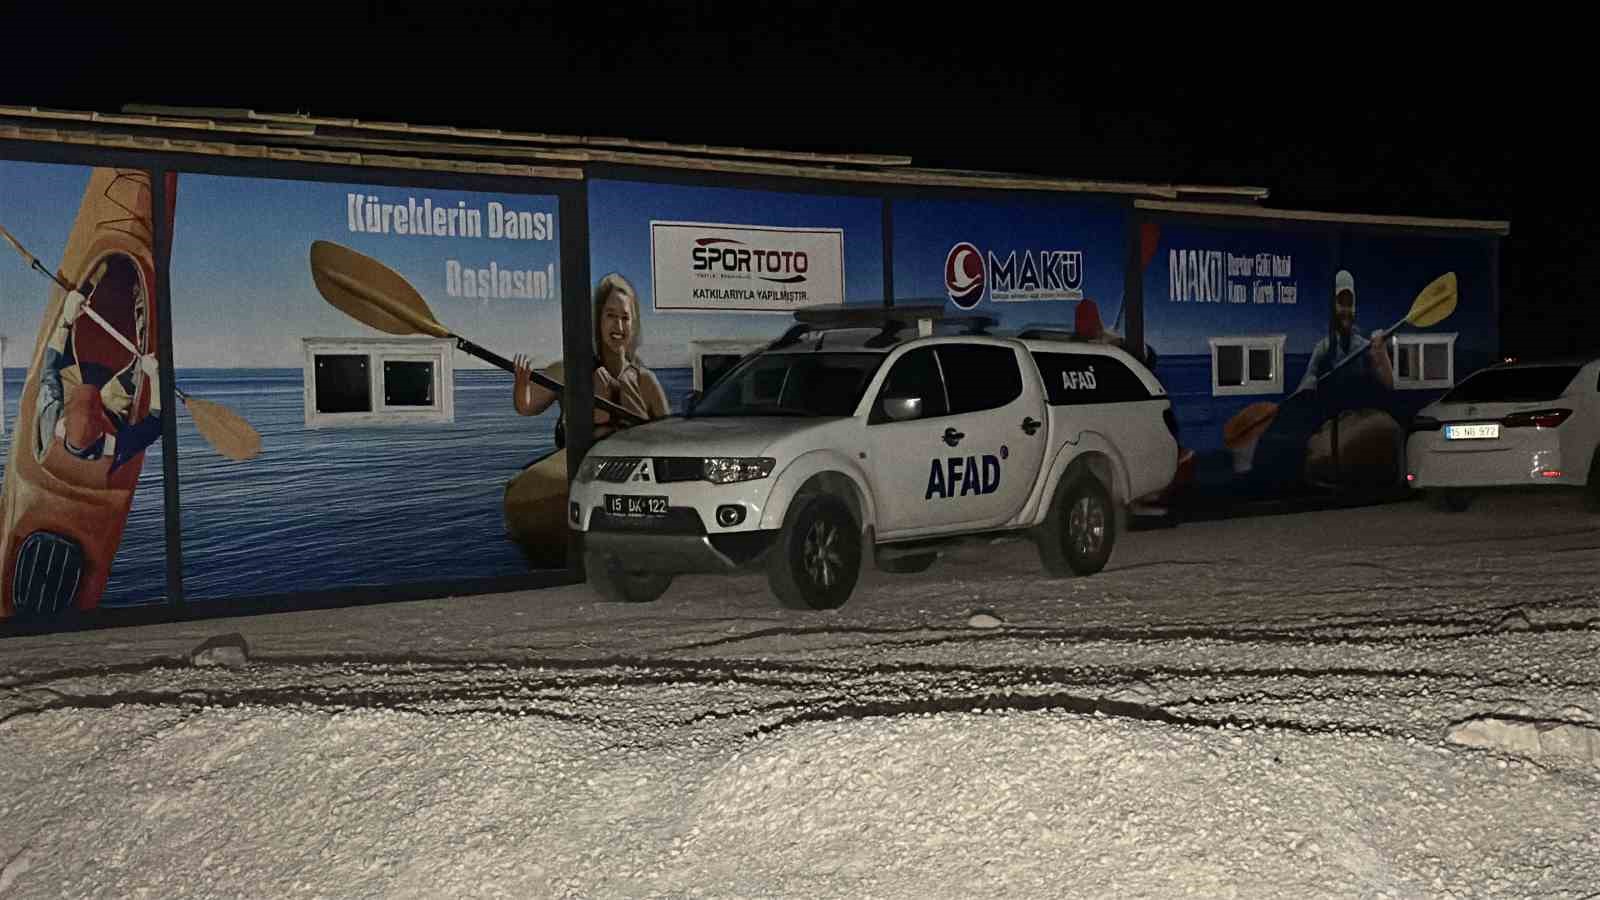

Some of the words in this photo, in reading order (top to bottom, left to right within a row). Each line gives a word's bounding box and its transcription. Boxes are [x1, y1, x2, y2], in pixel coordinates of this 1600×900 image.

[347, 193, 482, 238] Küreklerin
[487, 201, 553, 241] Dansı
[987, 249, 1083, 291] MAKÜ
[692, 288, 755, 300] KATKILARIYLA
[1062, 370, 1097, 390] AFAD
[925, 454, 1001, 500] AFAD
[612, 497, 622, 511] 15
[648, 498, 667, 513] 122
